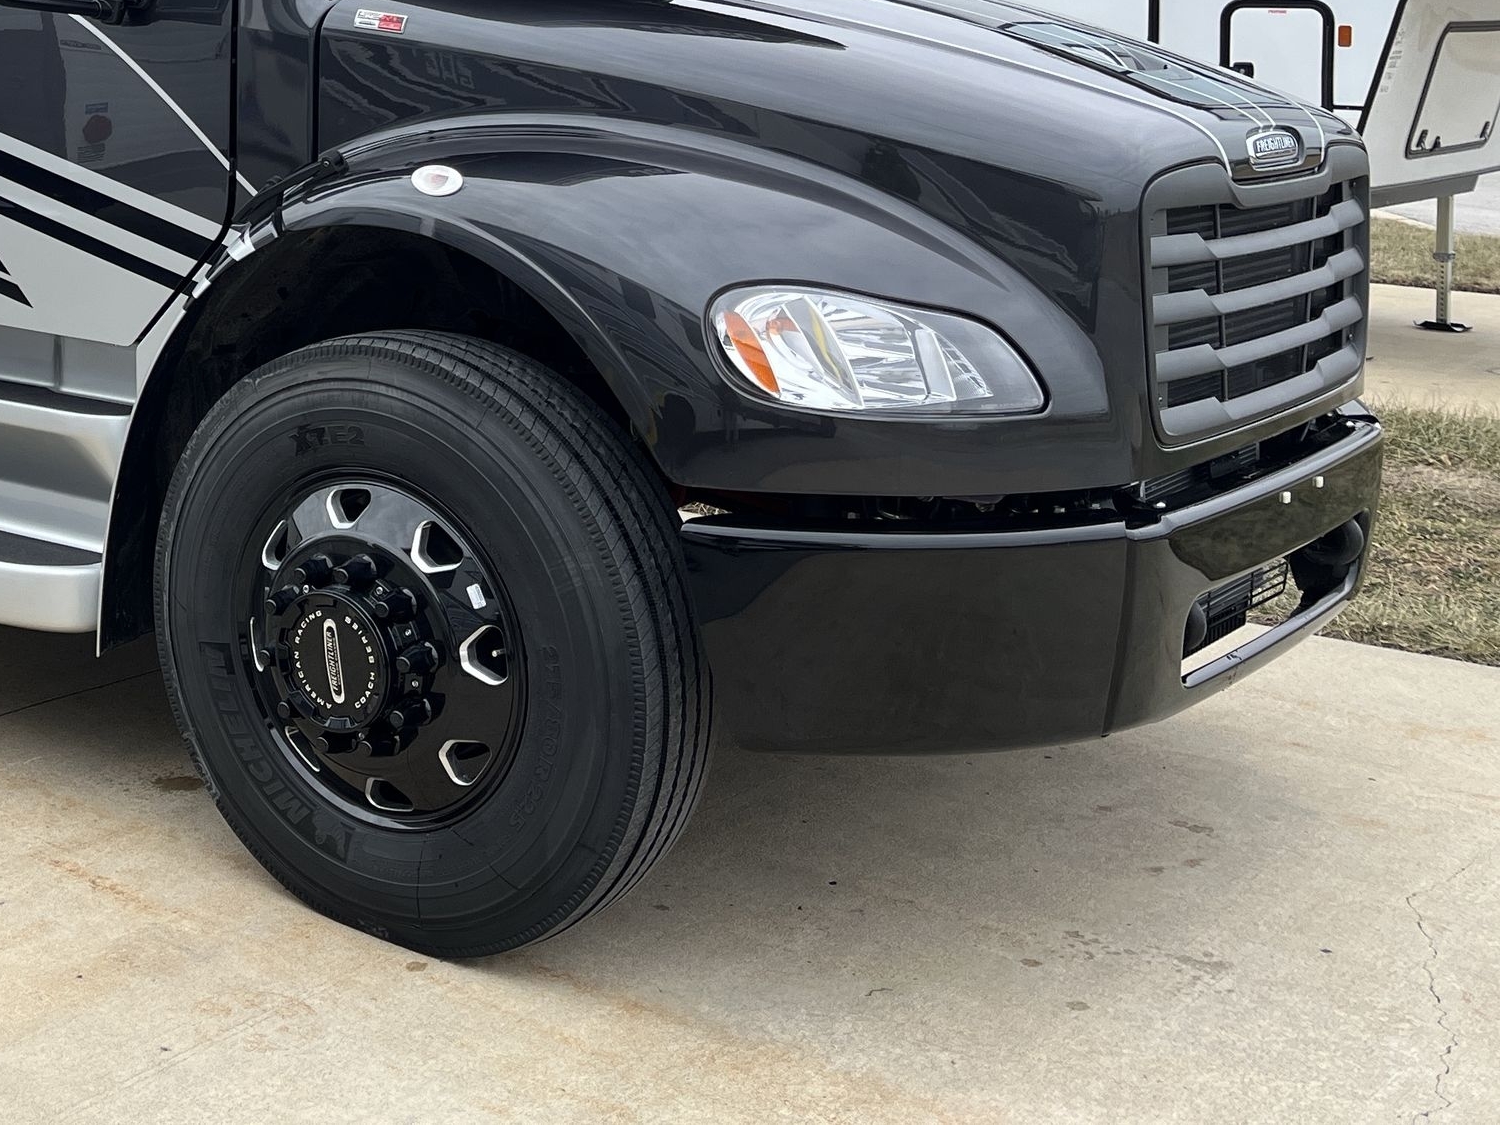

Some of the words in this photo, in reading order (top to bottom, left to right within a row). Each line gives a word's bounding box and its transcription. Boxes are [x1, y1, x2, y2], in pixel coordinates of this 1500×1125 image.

[294, 610, 322, 644] RACING
[344, 616, 375, 663] SERIES
[294, 651, 332, 709] AMERICAN
[326, 631, 339, 691] FREIGHTLINER
[354, 672, 375, 709] COACH
[204, 644, 312, 826] MICHELIN
